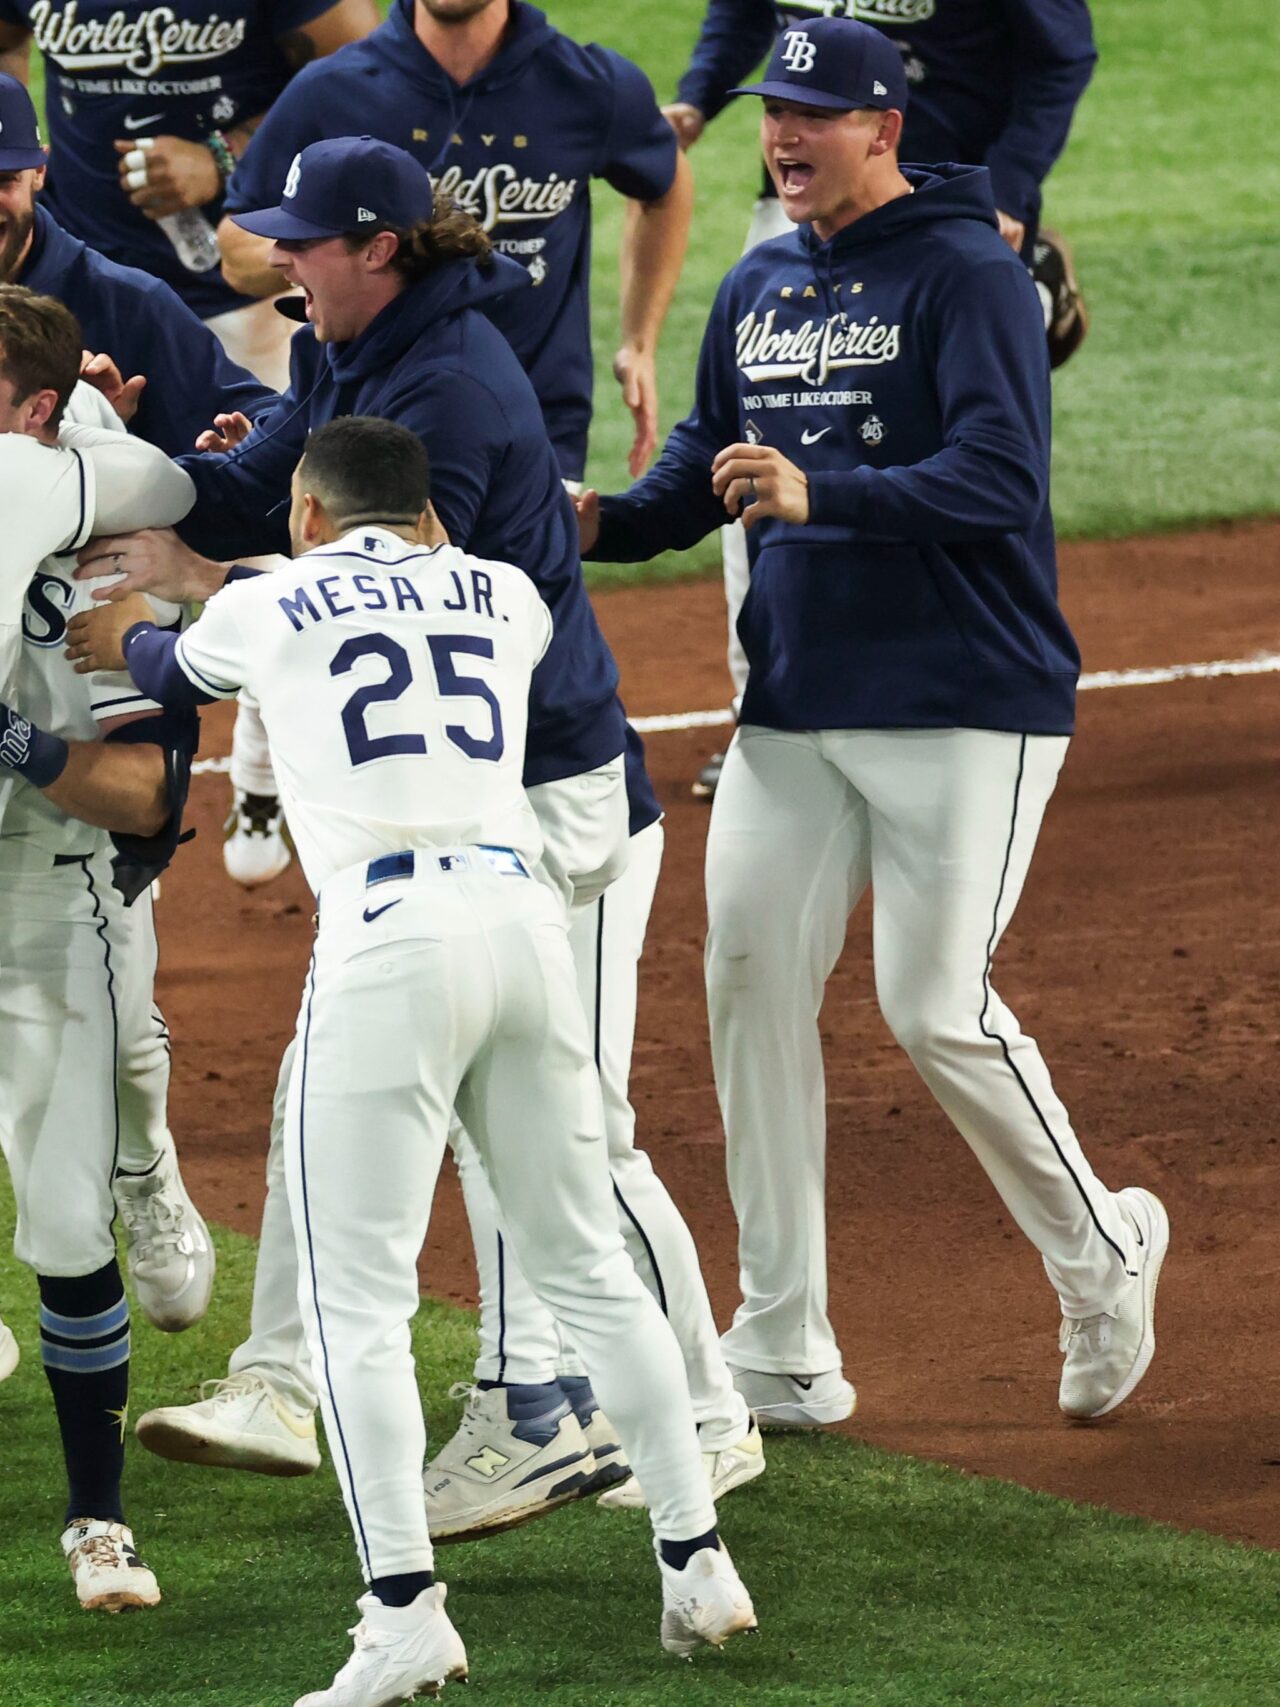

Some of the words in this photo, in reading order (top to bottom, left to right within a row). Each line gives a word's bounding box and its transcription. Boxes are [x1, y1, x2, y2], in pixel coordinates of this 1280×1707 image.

[126, 7, 246, 77] Series
[781, 31, 817, 73] TB
[78, 79, 111, 94] TIME
[112, 79, 147, 94] LIKE
[148, 75, 222, 95] OCTOBER
[735, 309, 824, 372] World
[742, 396, 762, 410] NO
[278, 575, 424, 632] MESA
[443, 570, 510, 622] JR.
[329, 632, 505, 767] 25
